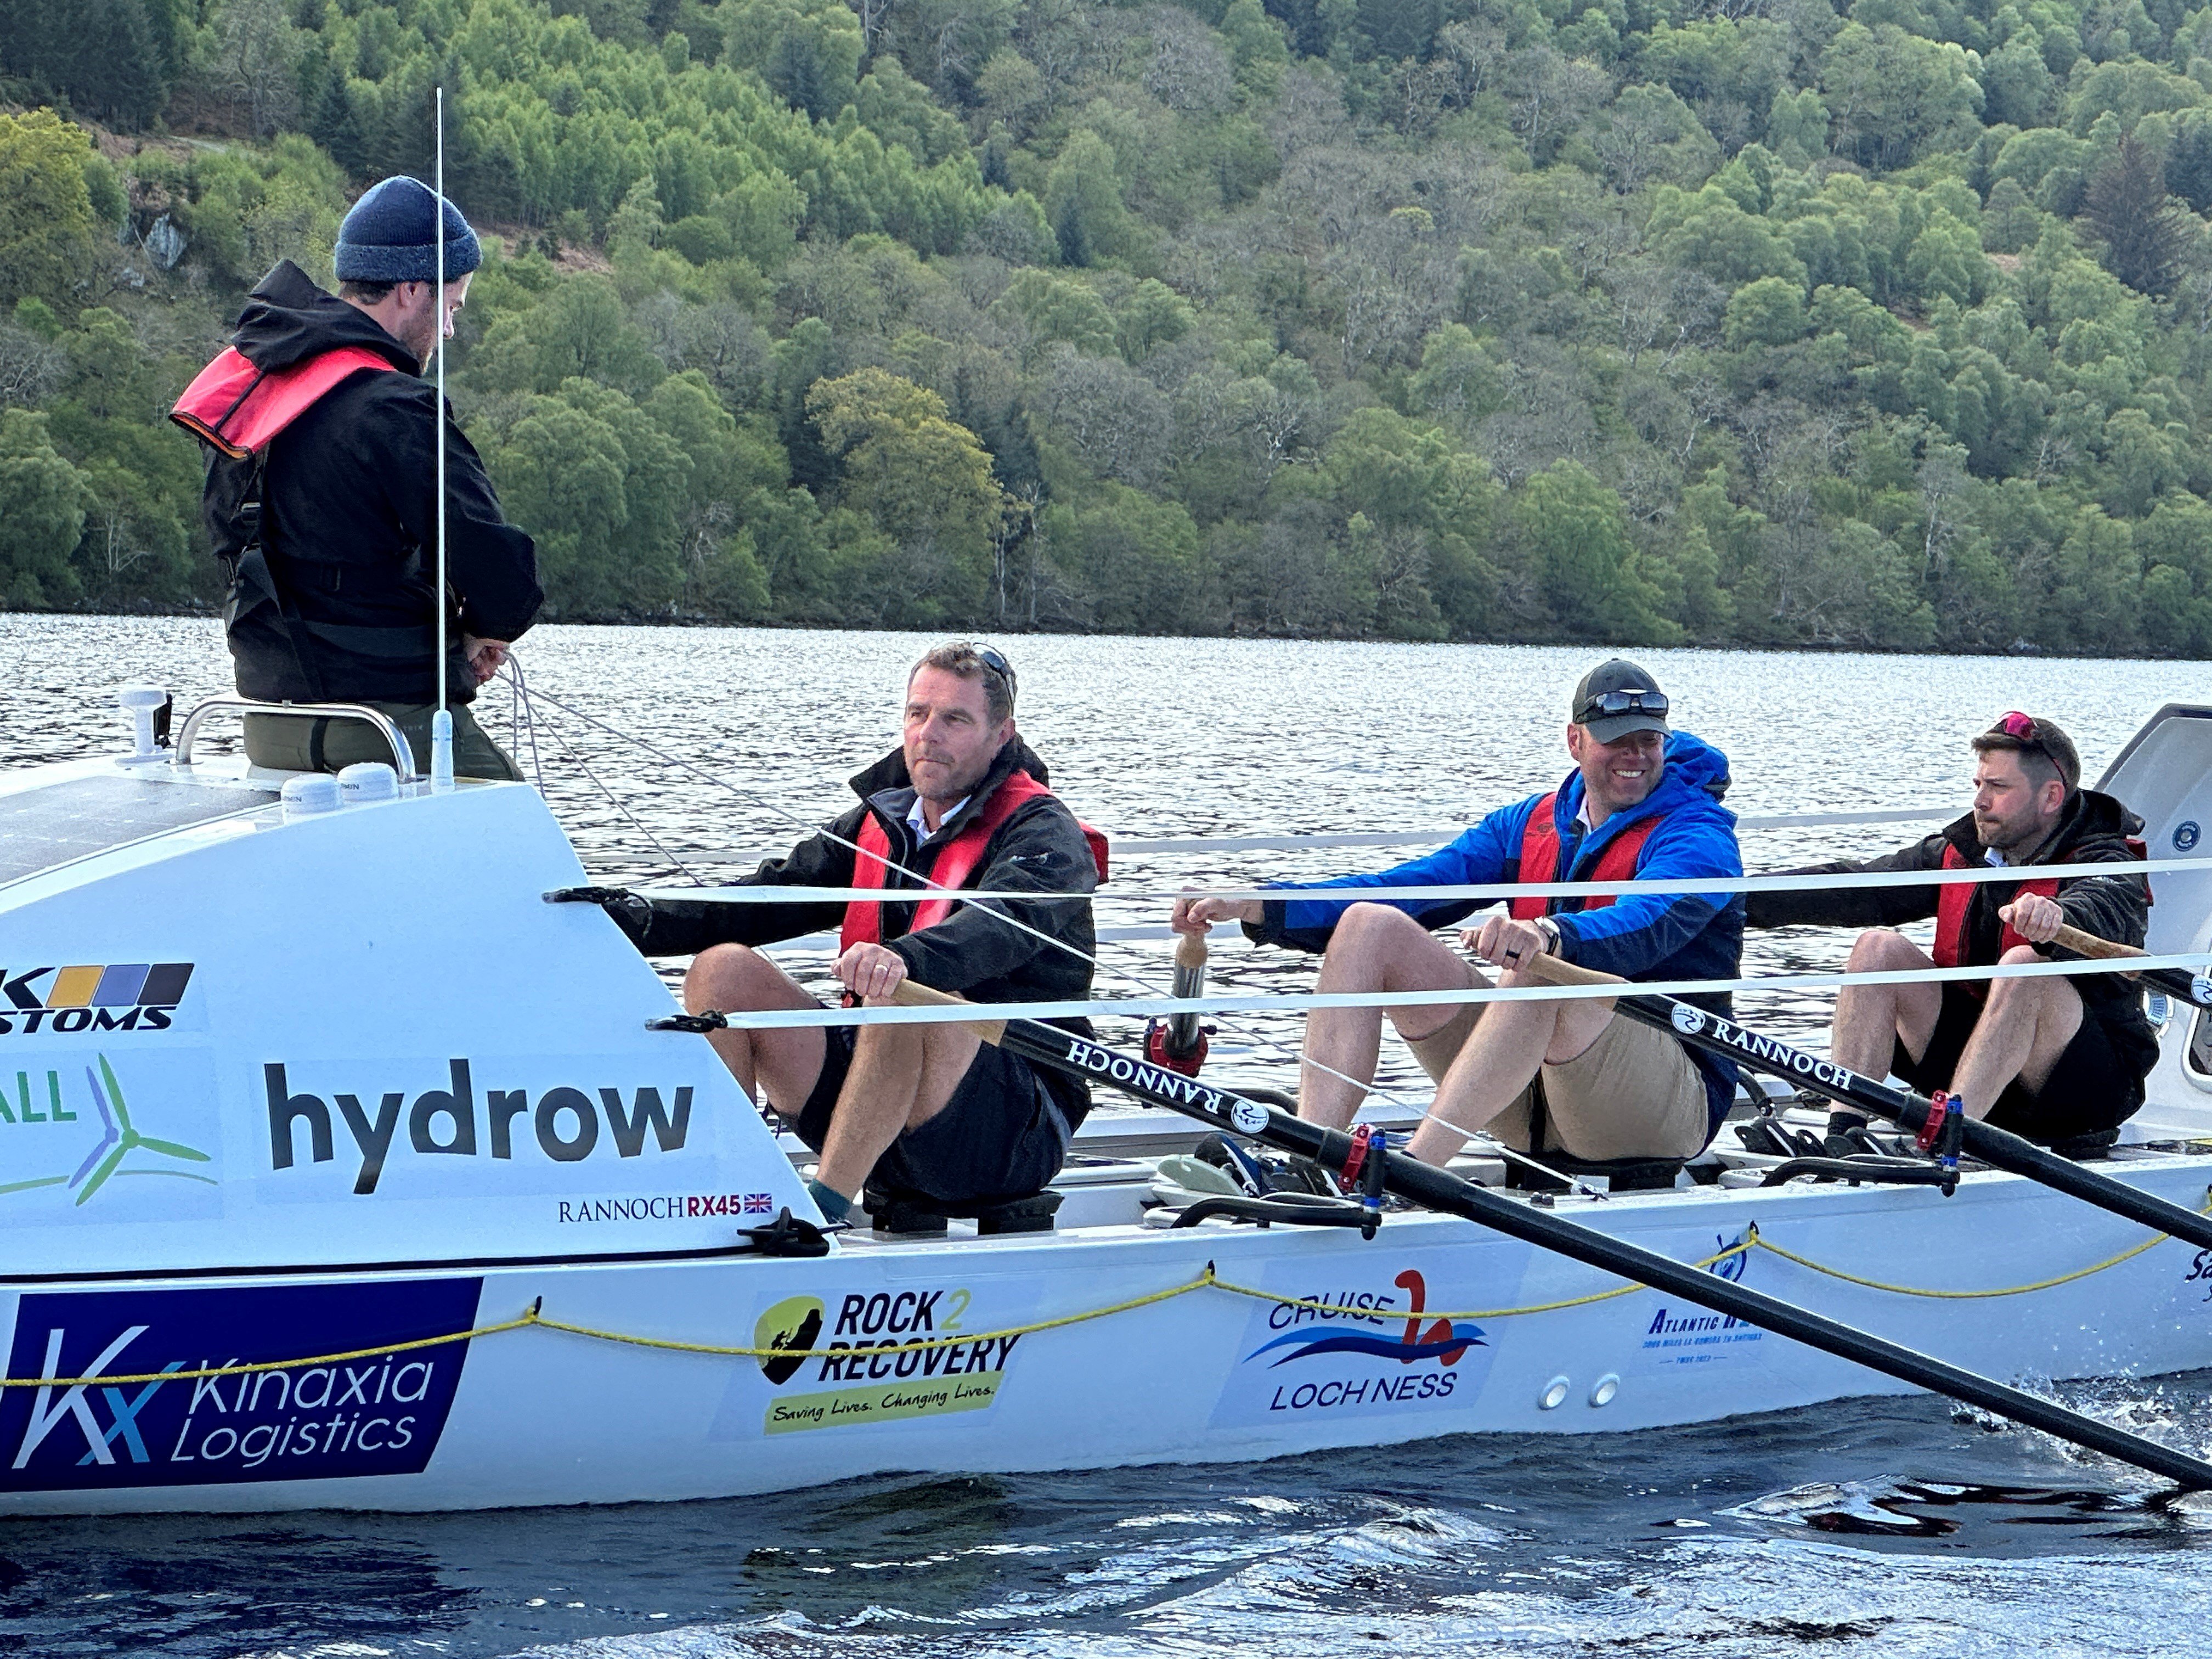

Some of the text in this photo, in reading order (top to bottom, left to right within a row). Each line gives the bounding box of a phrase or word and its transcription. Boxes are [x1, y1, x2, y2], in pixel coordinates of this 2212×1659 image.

[1065, 1041, 1222, 1114] RANNOCH
[1712, 1021, 1853, 1090] RANNOCH
[264, 1058, 693, 1195] hydrow
[558, 1195, 741, 1223] RANNOCH RX45
[834, 1289, 971, 1336] ROCK 2
[1269, 1291, 1396, 1330] CRUISE
[1648, 1308, 1719, 1335] ATLANTIC
[818, 1334, 1022, 1381] RECOVERY
[189, 1355, 435, 1415] Kinaxia
[772, 1383, 995, 1421] Saving Lives. Changing Lives.
[1270, 1372, 1458, 1411] LOCH NESS
[171, 1412, 416, 1468] Logistics
